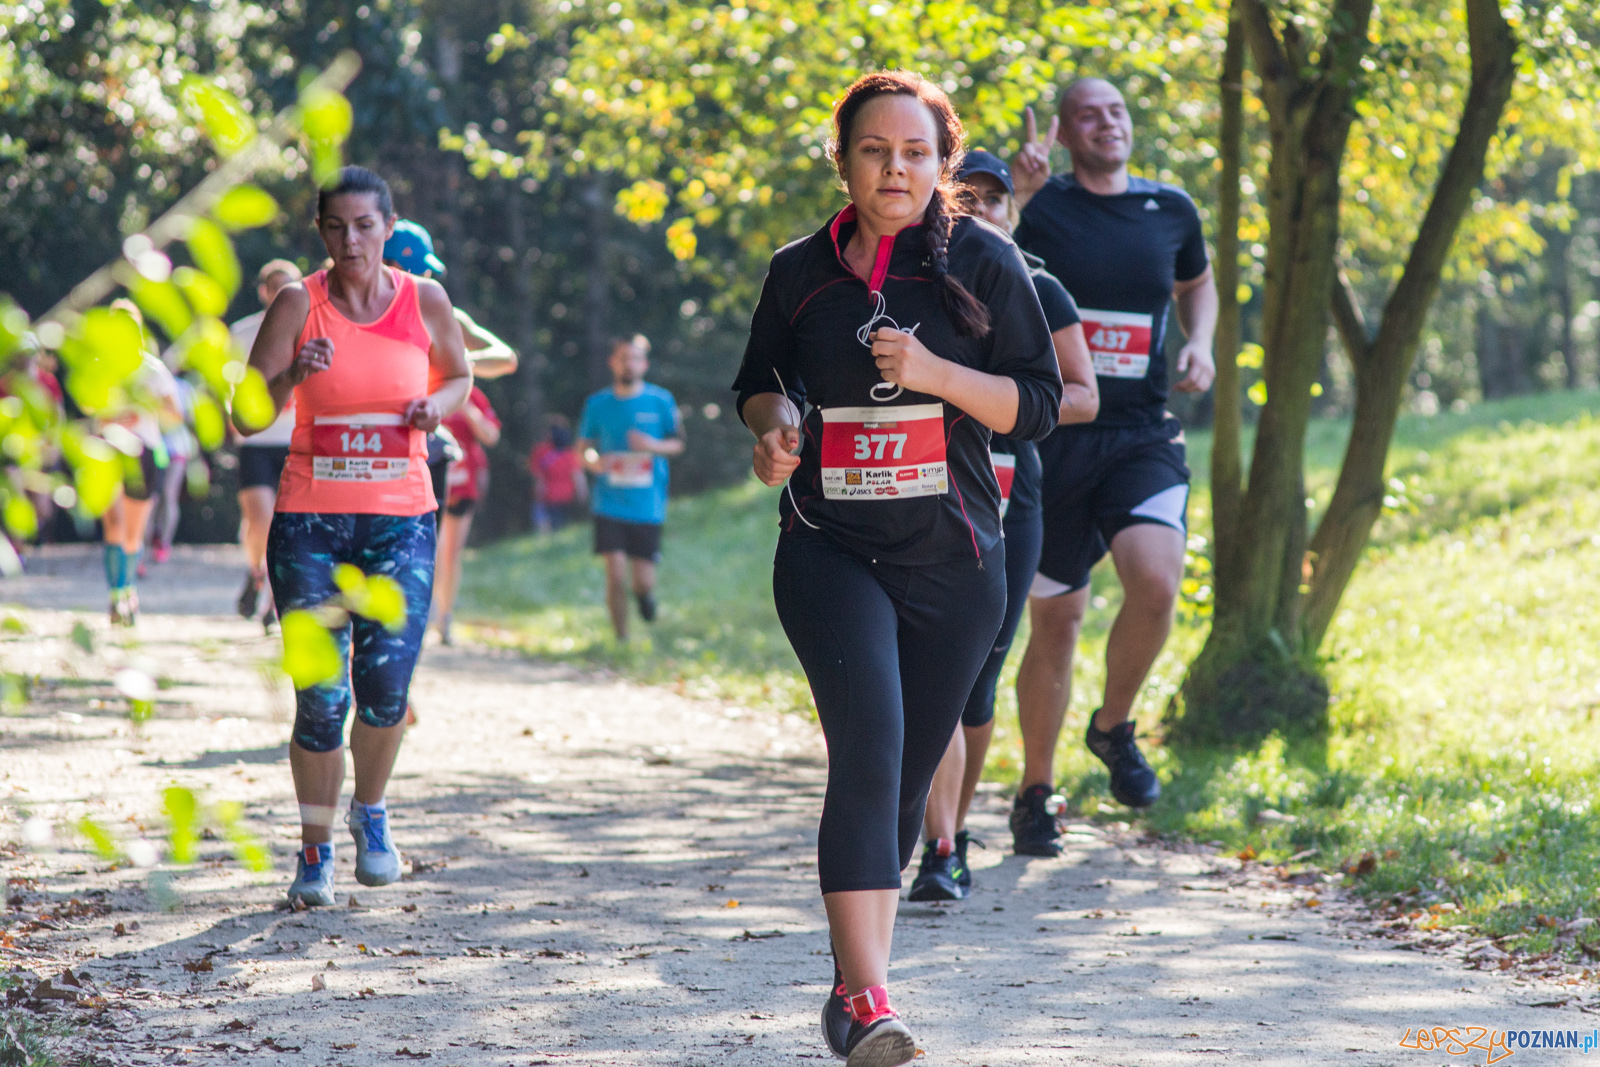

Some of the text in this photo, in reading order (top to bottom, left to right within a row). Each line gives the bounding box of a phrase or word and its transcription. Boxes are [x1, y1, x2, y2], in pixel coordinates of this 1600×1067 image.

[1090, 329, 1131, 350] 437
[341, 432, 382, 452] 144
[854, 433, 907, 460] 377
[866, 470, 893, 478] Karlik
